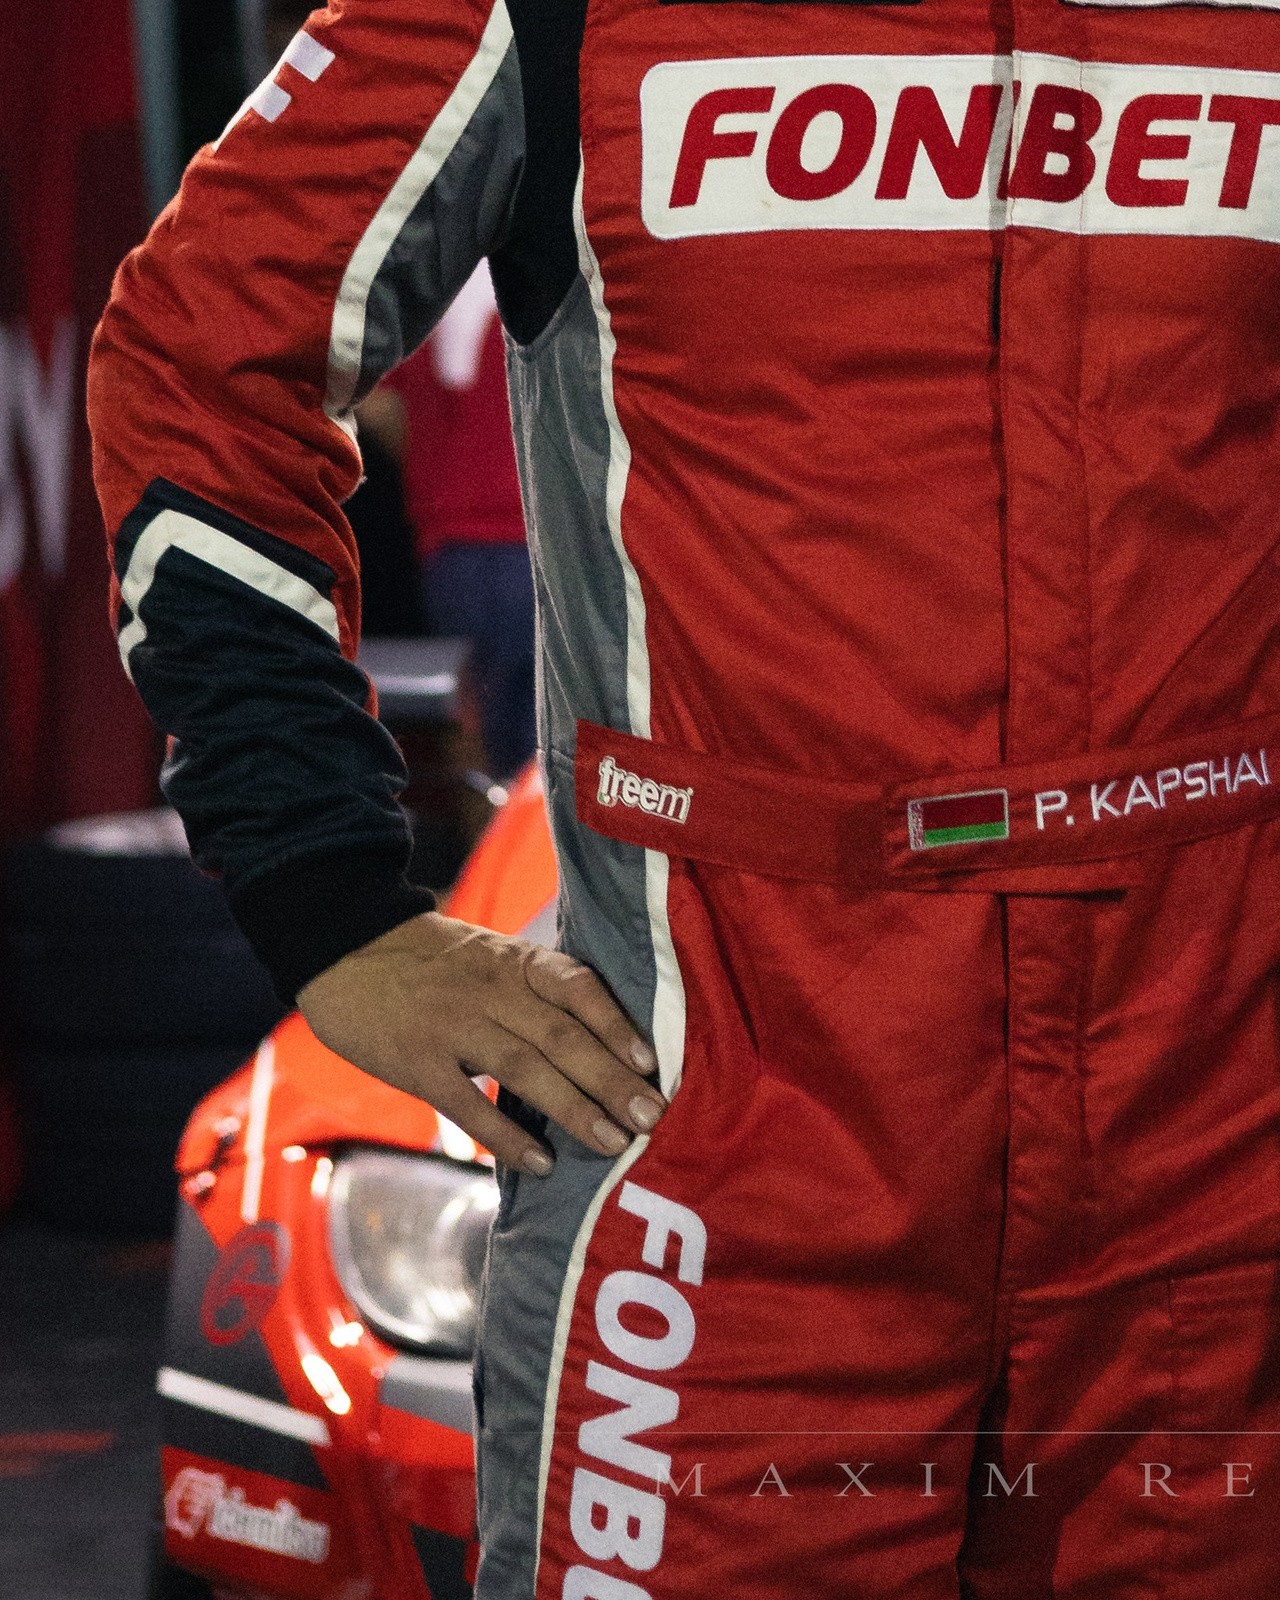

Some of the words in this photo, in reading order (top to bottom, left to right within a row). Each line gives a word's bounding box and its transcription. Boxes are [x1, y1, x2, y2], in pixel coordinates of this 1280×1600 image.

[598, 756, 691, 824] freem
[1034, 789, 1075, 831] P.
[1090, 749, 1272, 821] KAPSHAI
